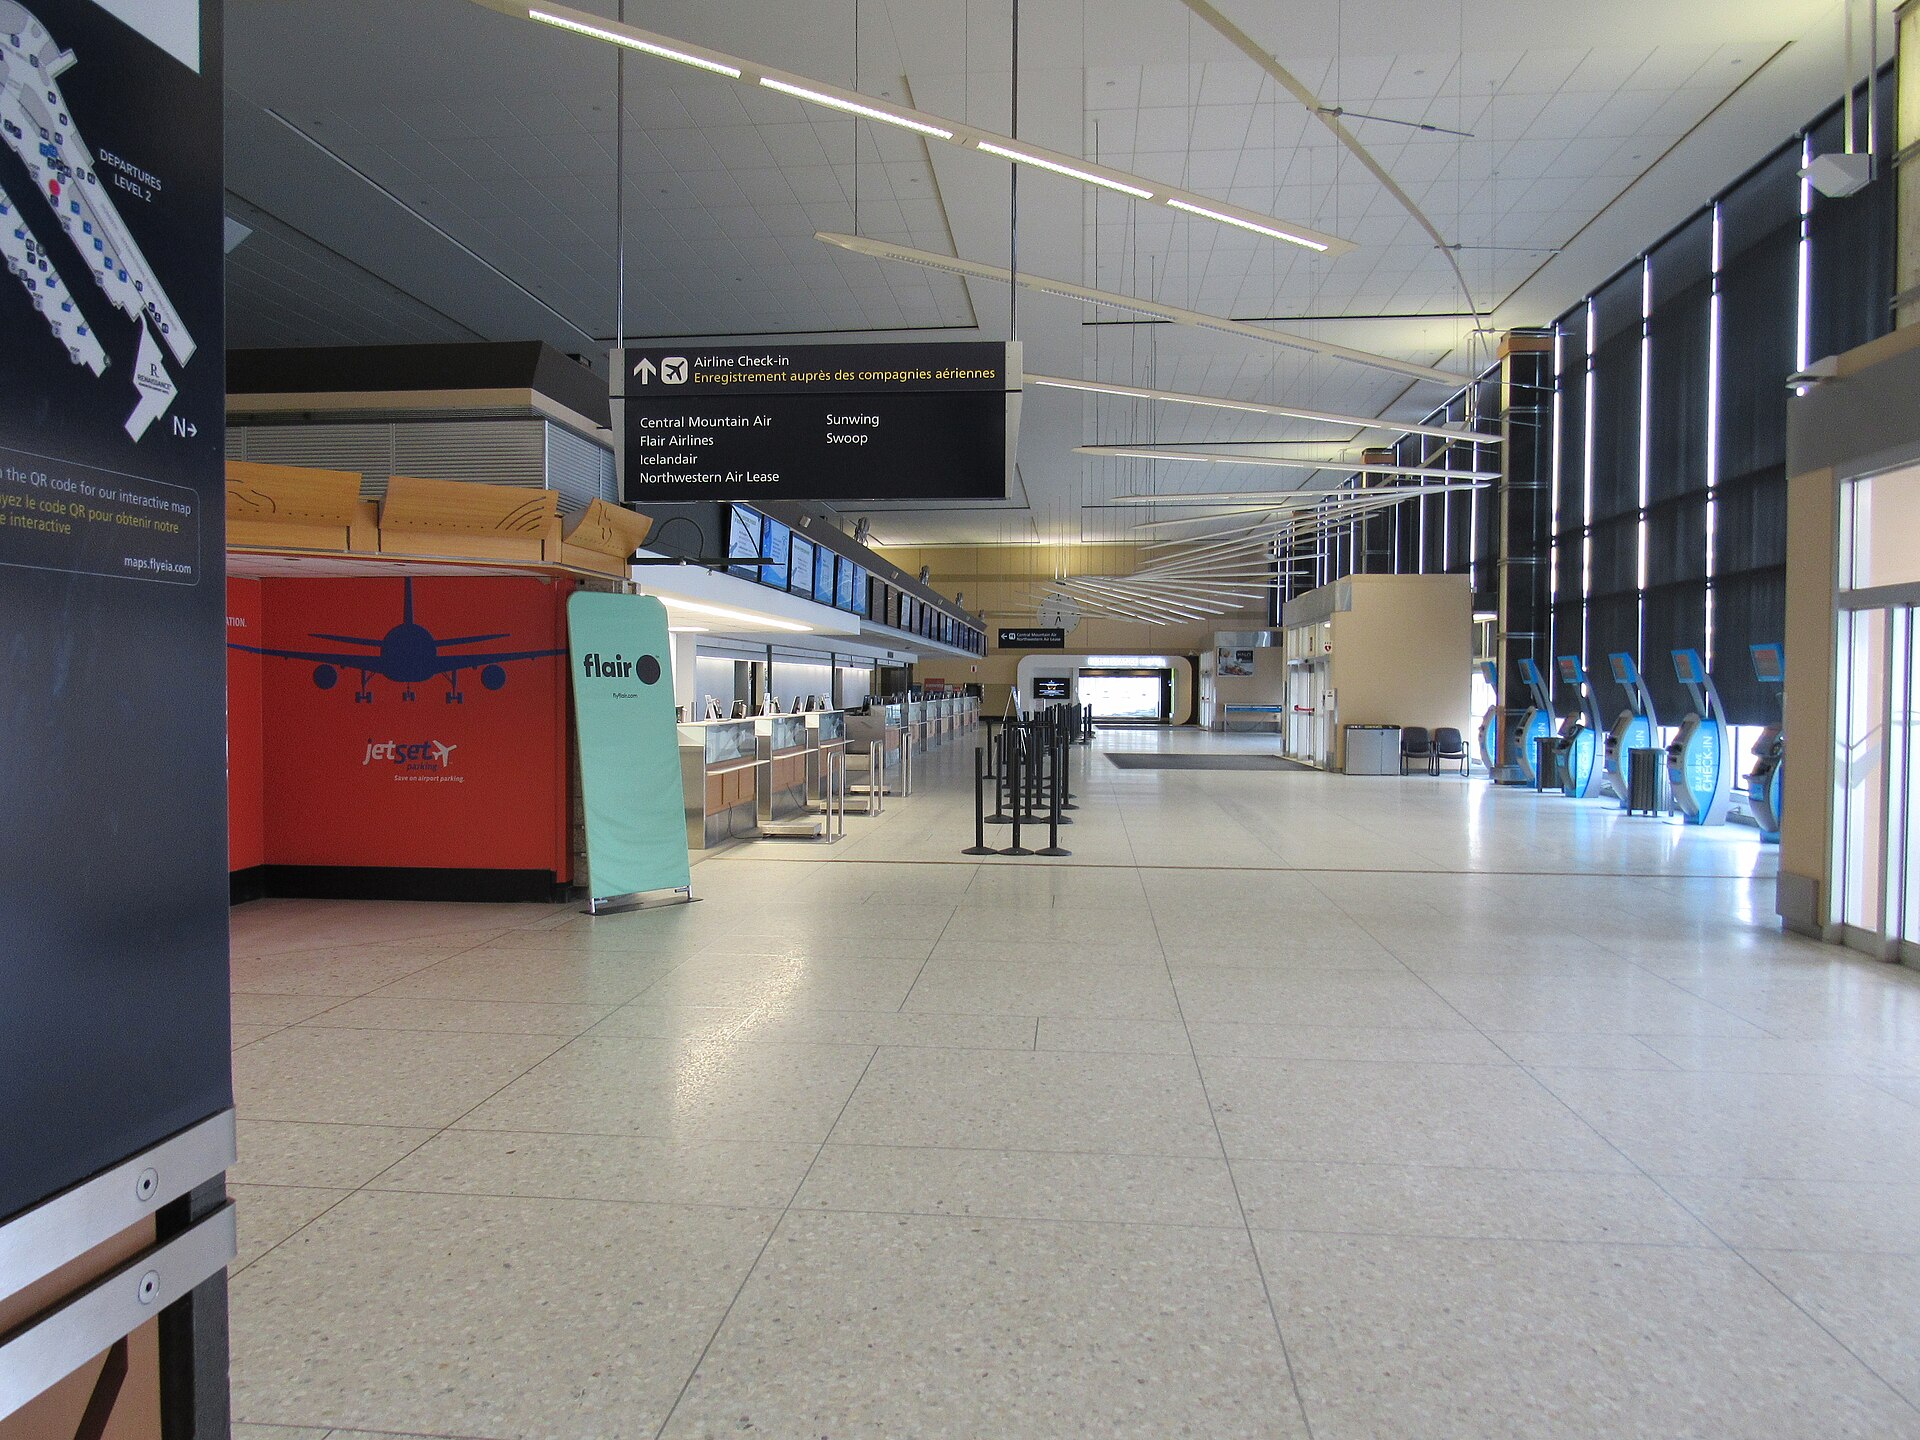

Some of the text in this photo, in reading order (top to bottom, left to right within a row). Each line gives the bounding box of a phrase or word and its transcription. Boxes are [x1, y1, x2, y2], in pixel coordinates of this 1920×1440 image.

[100, 148, 162, 191] DEPARTURES
[114, 173, 152, 203] LEVEL 2
[694, 355, 790, 368] Airline Check-in
[150, 363, 160, 378] R
[694, 367, 996, 386] Enregistrement auprès des compagnies aériennes
[173, 415, 186, 438] N
[640, 414, 772, 429] Central Mountain Air
[826, 413, 880, 428] Sunwing
[640, 434, 714, 447] Flair Airlines
[826, 432, 868, 446] Swoop
[640, 453, 698, 465] Icelandair
[640, 471, 780, 484] Northwestern Air Lease
[6, 466, 27, 484] the
[30, 471, 48, 488] QR
[50, 478, 77, 493] code
[80, 480, 96, 497] for
[98, 488, 117, 500] our
[119, 489, 169, 511] interactive
[171, 502, 192, 517] map
[25, 494, 36, 510] le
[39, 500, 67, 515] code
[69, 503, 86, 518] QR
[88, 509, 113, 522] pour
[115, 511, 152, 529] obtenir
[154, 521, 179, 534] notre
[10, 512, 72, 535] interactive
[124, 557, 192, 574] maps.flyeia.com
[583, 653, 632, 678] flair
[362, 738, 433, 766] jetset
[407, 762, 438, 772] parking
[1702, 735, 1712, 791] CHECK-IN
[419, 775, 439, 783] airport
